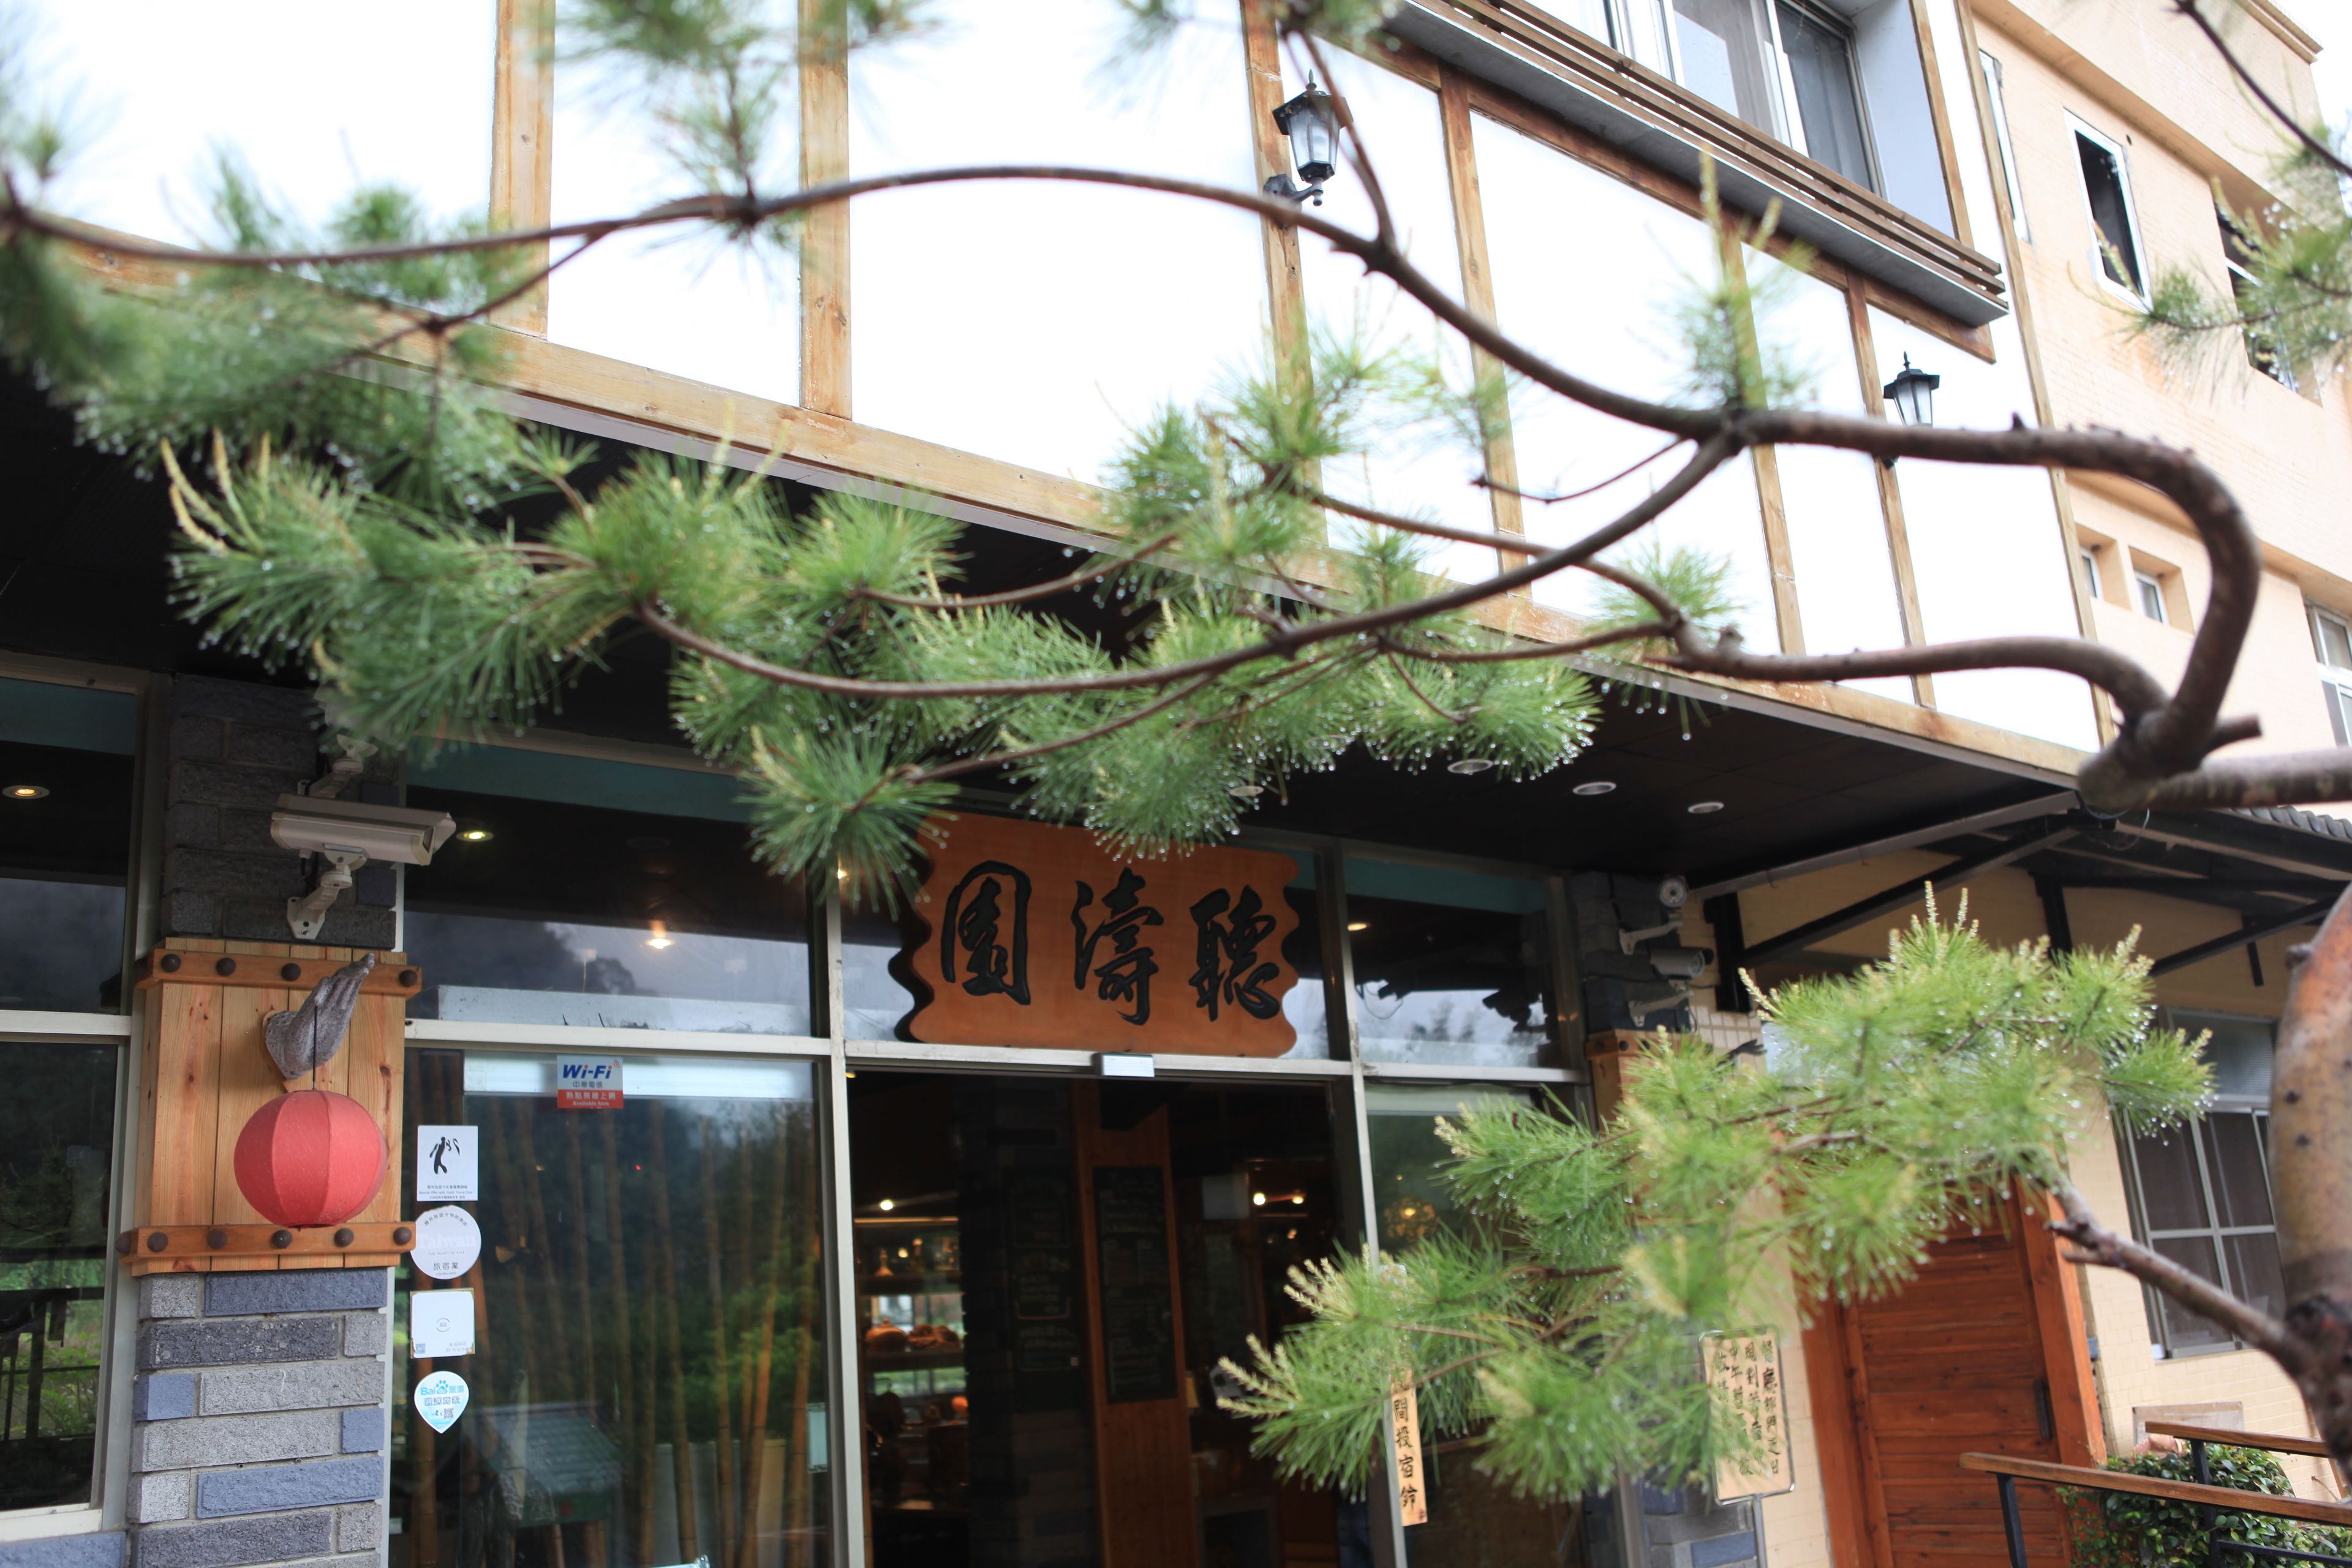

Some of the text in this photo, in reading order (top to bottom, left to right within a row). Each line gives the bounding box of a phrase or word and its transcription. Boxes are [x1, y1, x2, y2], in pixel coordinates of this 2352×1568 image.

[562, 1064, 613, 1079] Wi-Fi
[433, 1262, 459, 1271] 旅宿業
